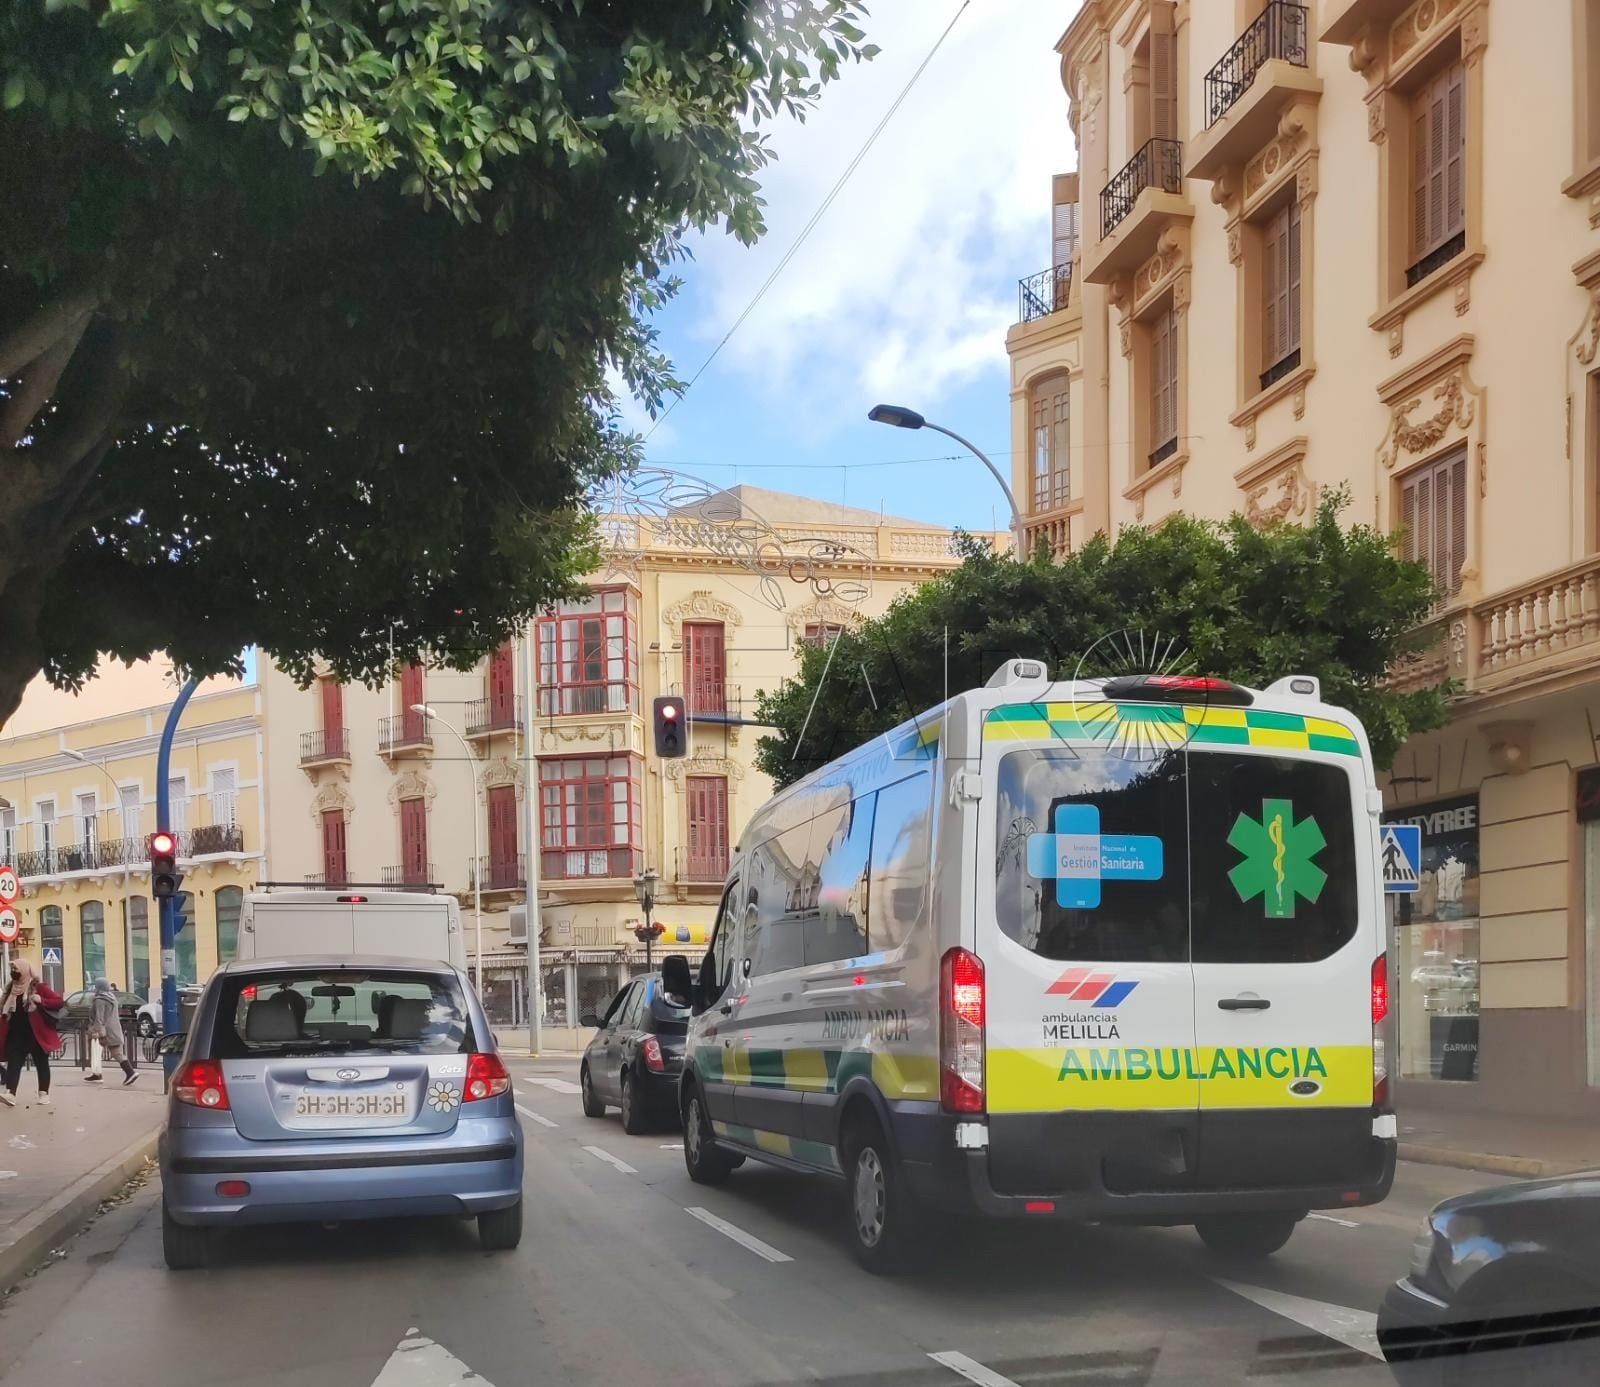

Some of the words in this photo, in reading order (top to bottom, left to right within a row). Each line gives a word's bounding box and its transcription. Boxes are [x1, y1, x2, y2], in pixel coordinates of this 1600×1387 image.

[1061, 855, 1098, 869] Gestión
[1101, 856, 1145, 870] Sanitaria
[0, 879, 14, 892] 20
[823, 1009, 910, 1041] AMBULANCIA
[1042, 1012, 1118, 1023] ambulancias
[1043, 1024, 1121, 1039] MELILLA
[1443, 1043, 1477, 1052] GARMIN
[1057, 1047, 1329, 1082] AMBULANCIA
